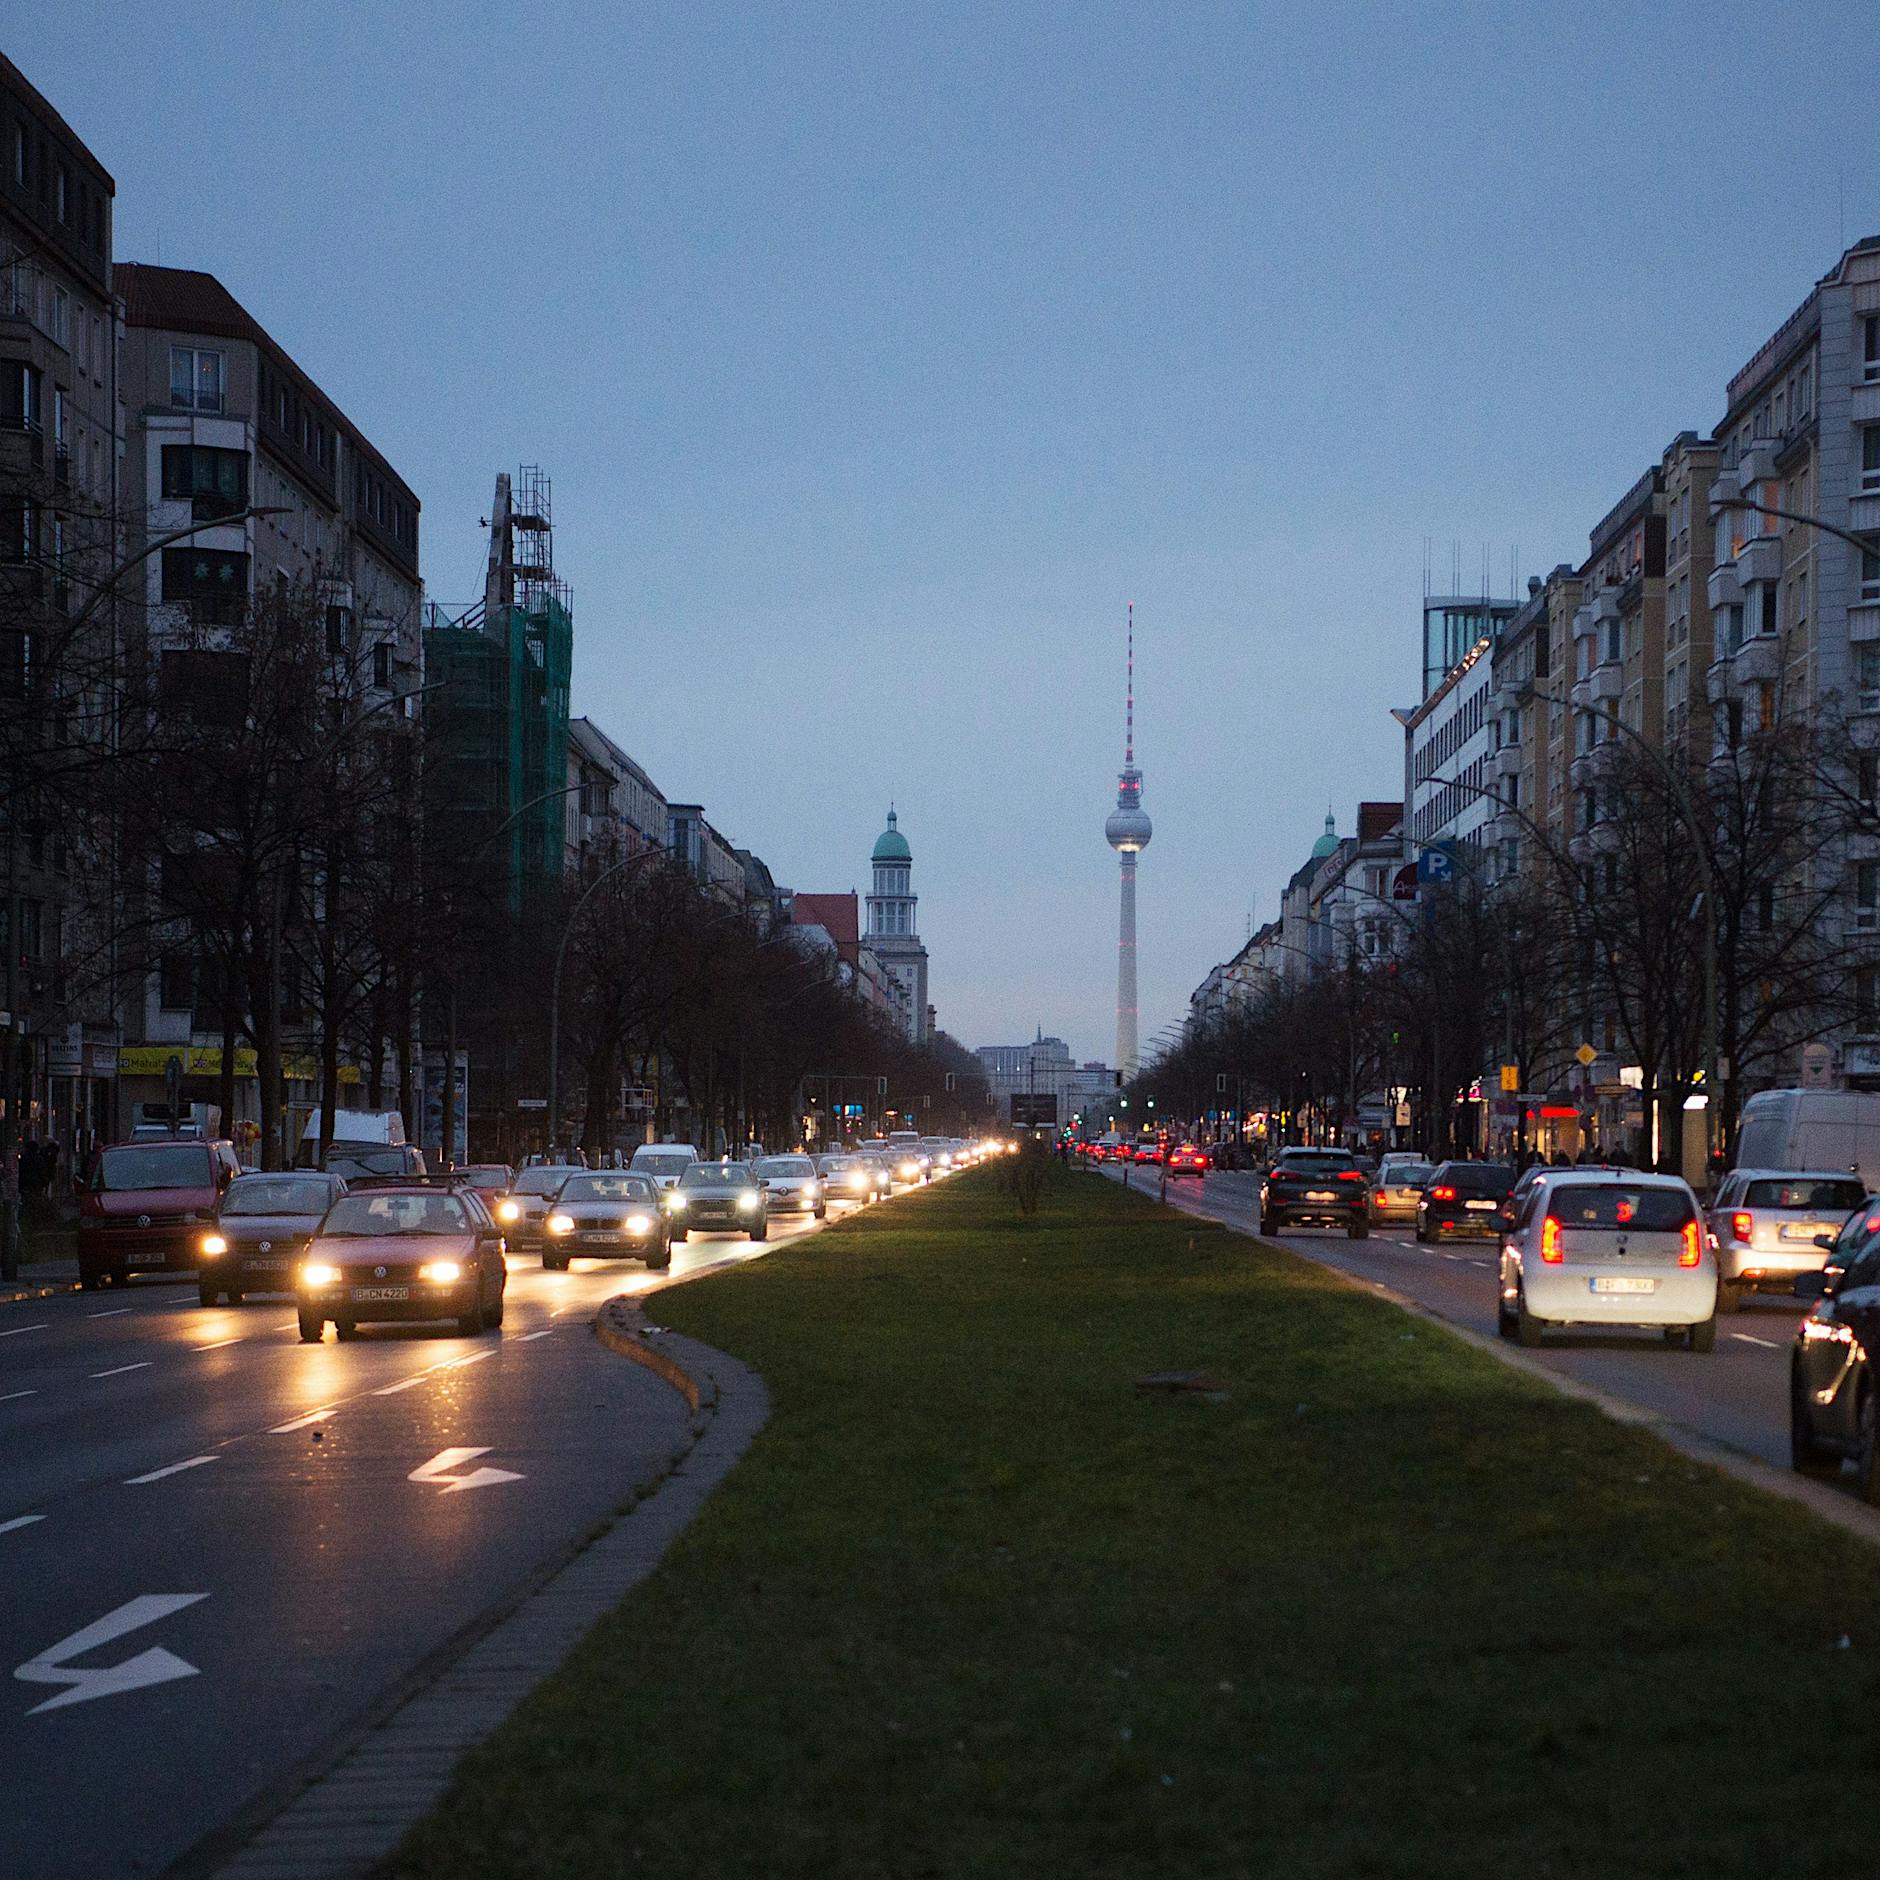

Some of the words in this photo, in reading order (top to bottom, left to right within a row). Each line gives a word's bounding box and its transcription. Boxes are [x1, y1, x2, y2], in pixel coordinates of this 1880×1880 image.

[1429, 853, 1448, 874] P
[357, 1290, 364, 1299] B
[369, 1290, 382, 1299] CN
[383, 1289, 407, 1299] 4220
